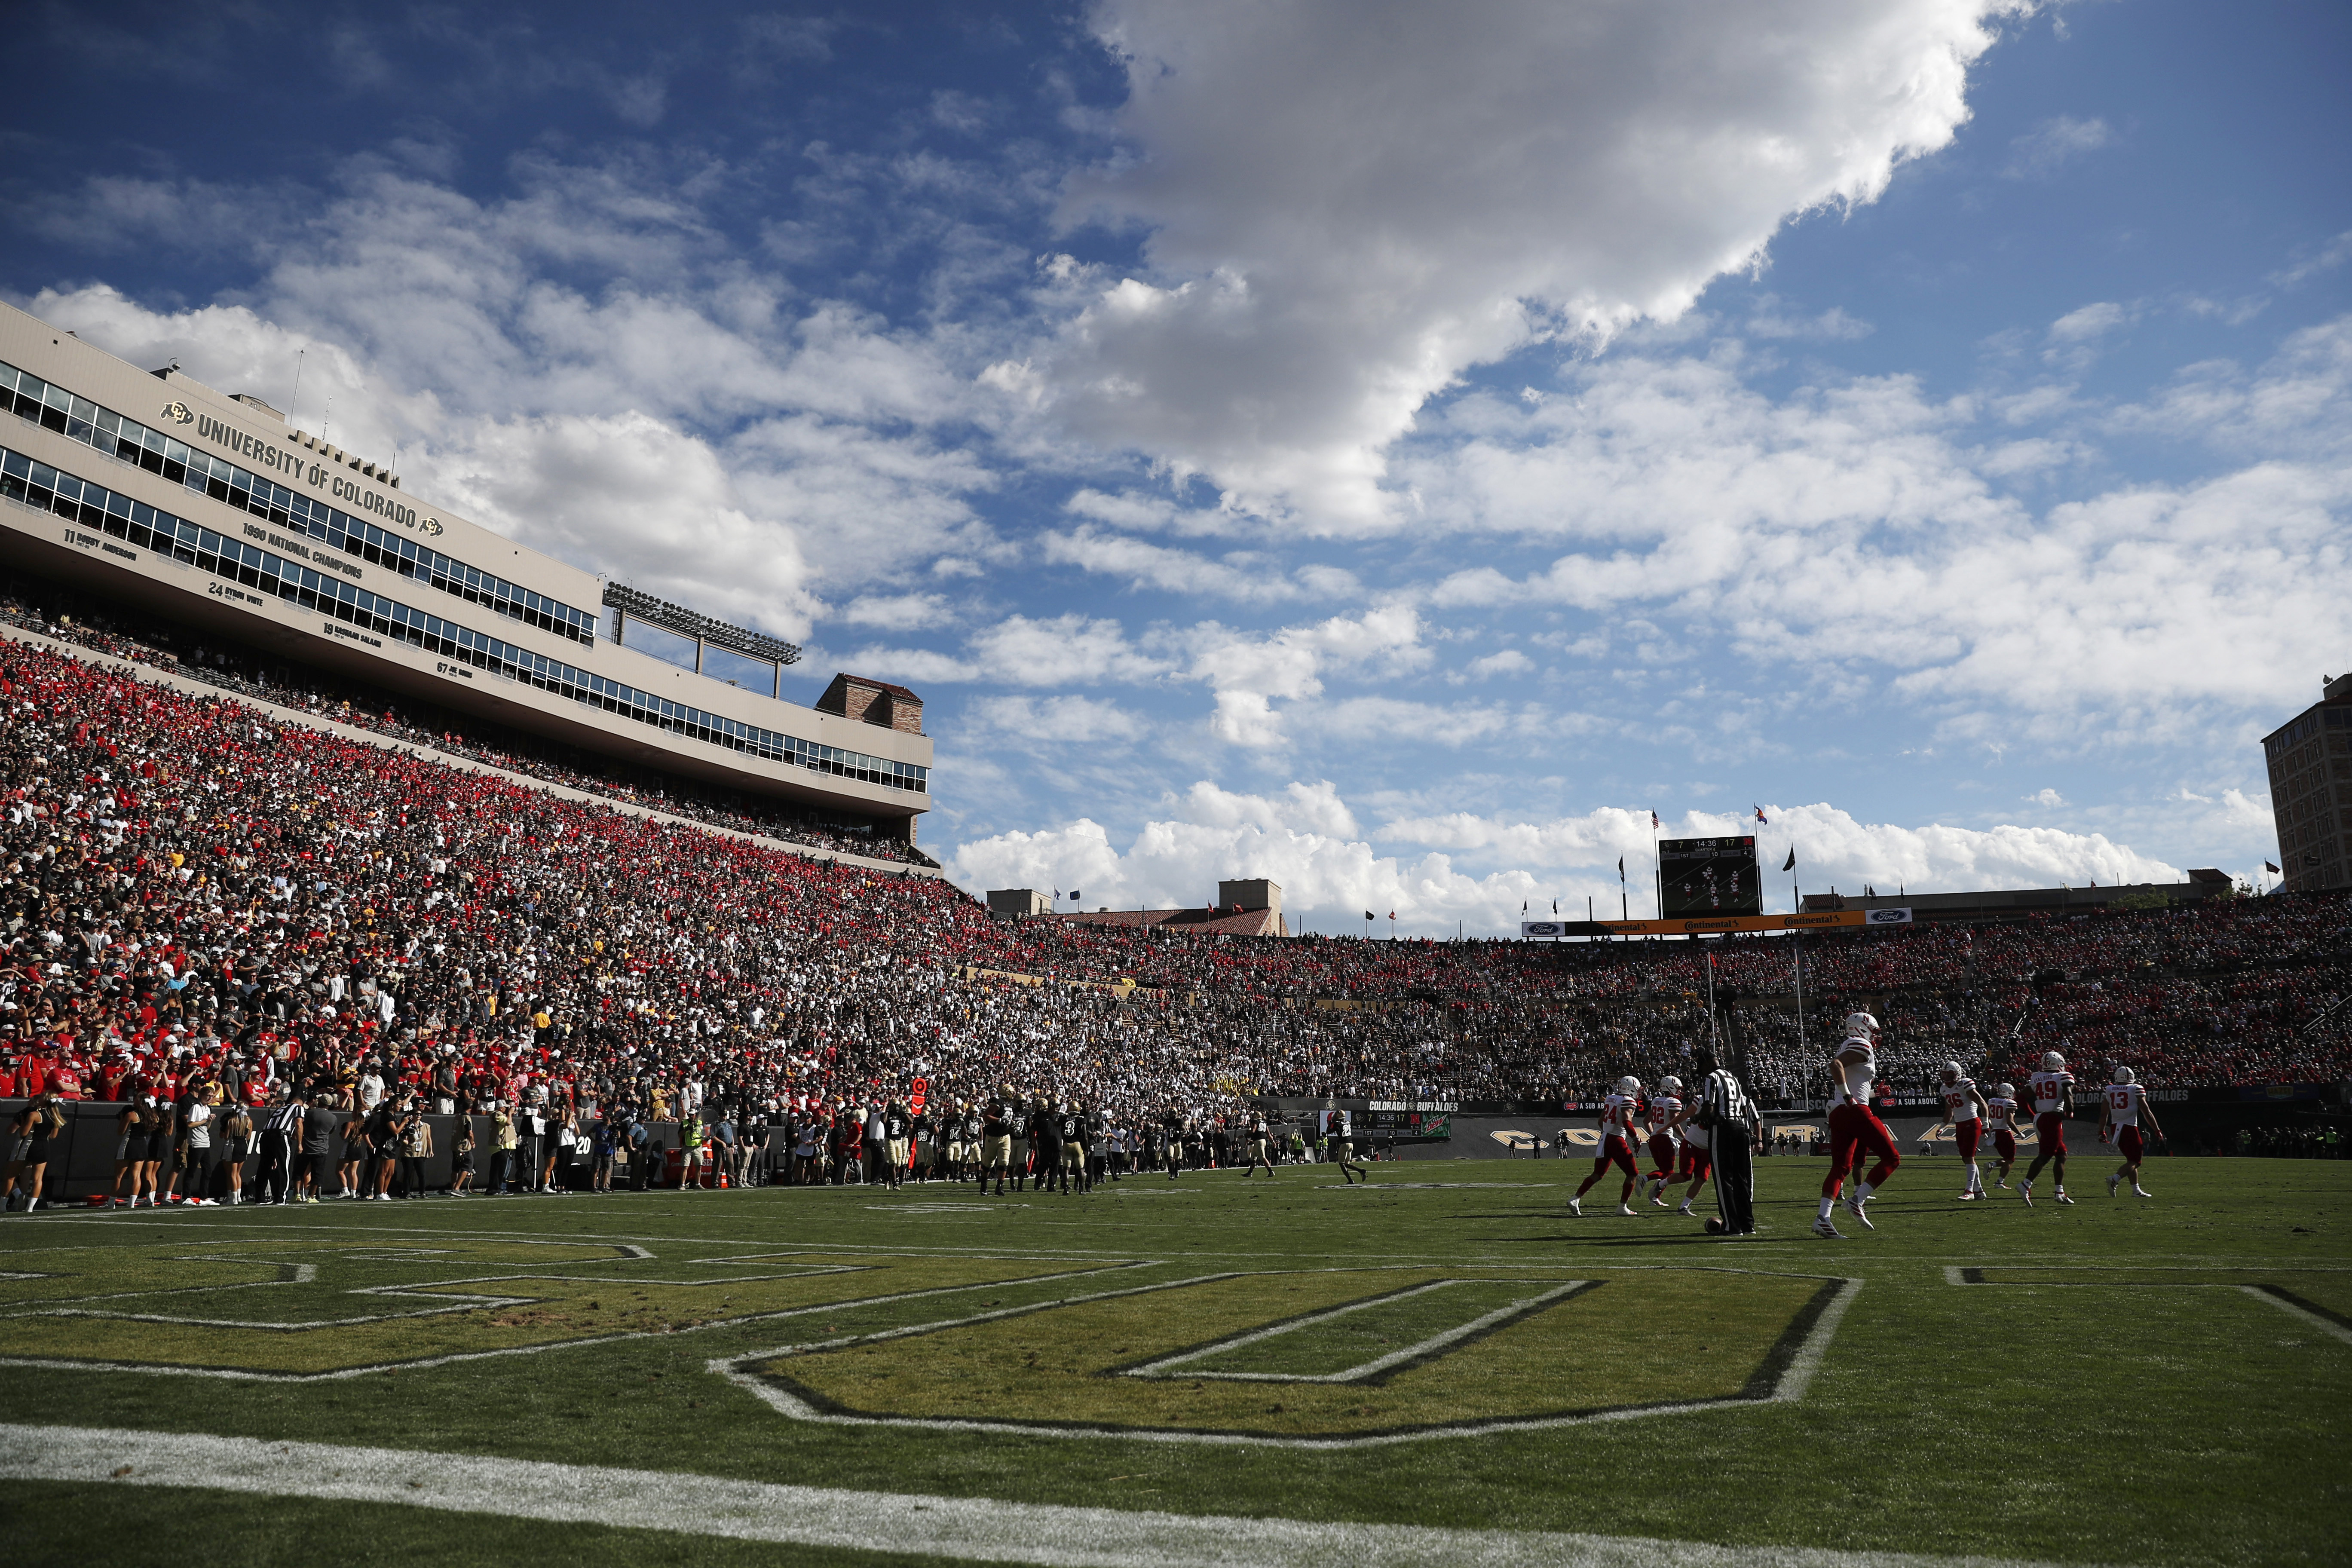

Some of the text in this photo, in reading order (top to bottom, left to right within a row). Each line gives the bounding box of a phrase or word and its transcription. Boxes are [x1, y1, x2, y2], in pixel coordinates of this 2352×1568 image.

[198, 412, 416, 529] UNIVERSITY OF COLORADO
[64, 529, 75, 543] 11
[77, 533, 137, 561] BOBBY ANDERSON
[243, 522, 362, 579] 1990 NATIONAL CHAMPIONS
[208, 582, 223, 596] 24
[324, 622, 334, 635] 19
[437, 662, 448, 674] 67
[1743, 837, 1752, 845] N
[1784, 916, 1832, 927] Continental
[1878, 911, 1899, 920] Ford
[1534, 925, 1553, 933] Ford
[1607, 923, 1640, 931] tinental
[1684, 920, 1731, 931] Continental
[1724, 1077, 1737, 1099] B
[2035, 1081, 2057, 1100] 49
[2073, 1090, 2188, 1104] COLORA FFALOES
[2110, 1092, 2128, 1109] 13
[1369, 1101, 1406, 1111] COLORADO
[1417, 1101, 1458, 1112] BUFFALOES
[1989, 1105, 2004, 1119] 30
[1410, 1114, 1420, 1124] N
[1603, 1104, 1617, 1124] 24
[892, 1122, 900, 1134] 2
[949, 1129, 961, 1139] 14
[1065, 1121, 1075, 1135] 3
[918, 1131, 928, 1141] 13
[576, 1136, 591, 1155] 20
